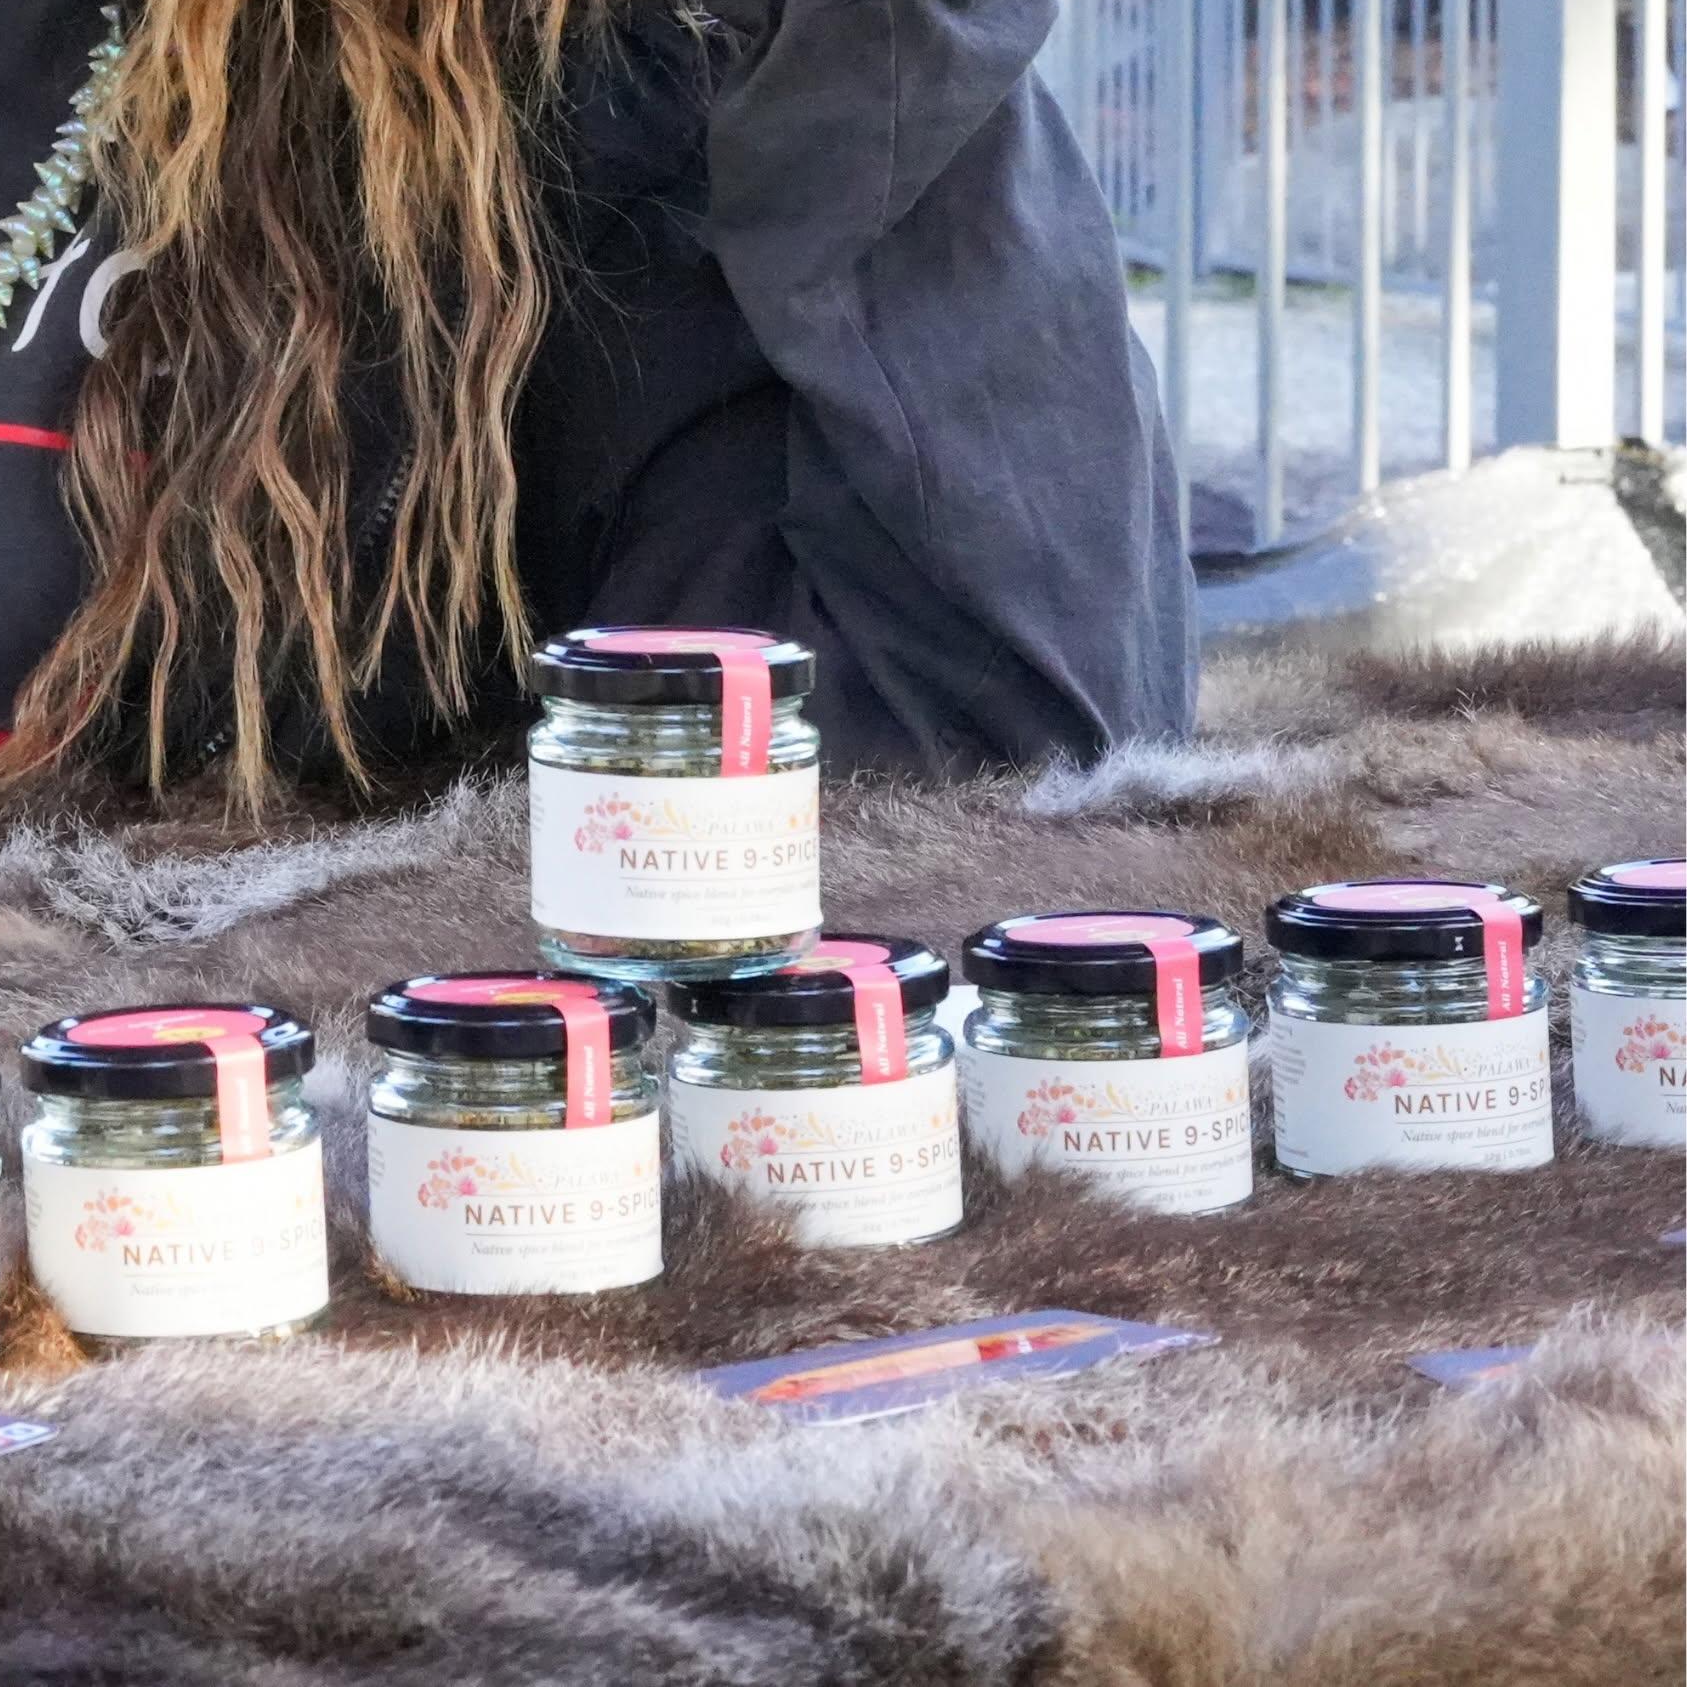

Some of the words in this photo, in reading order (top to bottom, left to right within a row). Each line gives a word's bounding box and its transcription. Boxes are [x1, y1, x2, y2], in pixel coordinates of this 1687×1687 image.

[738, 695, 753, 747] Natural
[619, 847, 729, 871] NATIVE
[1496, 940, 1510, 991] Natural
[1171, 977, 1185, 1029] Natural
[1499, 992, 1512, 1013] All
[872, 1002, 889, 1055] Natural
[1175, 1030, 1188, 1049] All
[583, 1045, 596, 1097] Natural
[879, 1056, 891, 1076] All
[1394, 1089, 1497, 1114] NATIVE
[1508, 1077, 1548, 1107] 9-SP
[583, 1100, 596, 1120] All
[1064, 1128, 1171, 1152] NATIVE
[1185, 1111, 1248, 1146] 9-SPIC
[1401, 1128, 1443, 1143] Native
[767, 1157, 876, 1184] NATIVE
[465, 1203, 576, 1225] NATIVE
[123, 1240, 234, 1267] NATIVE
